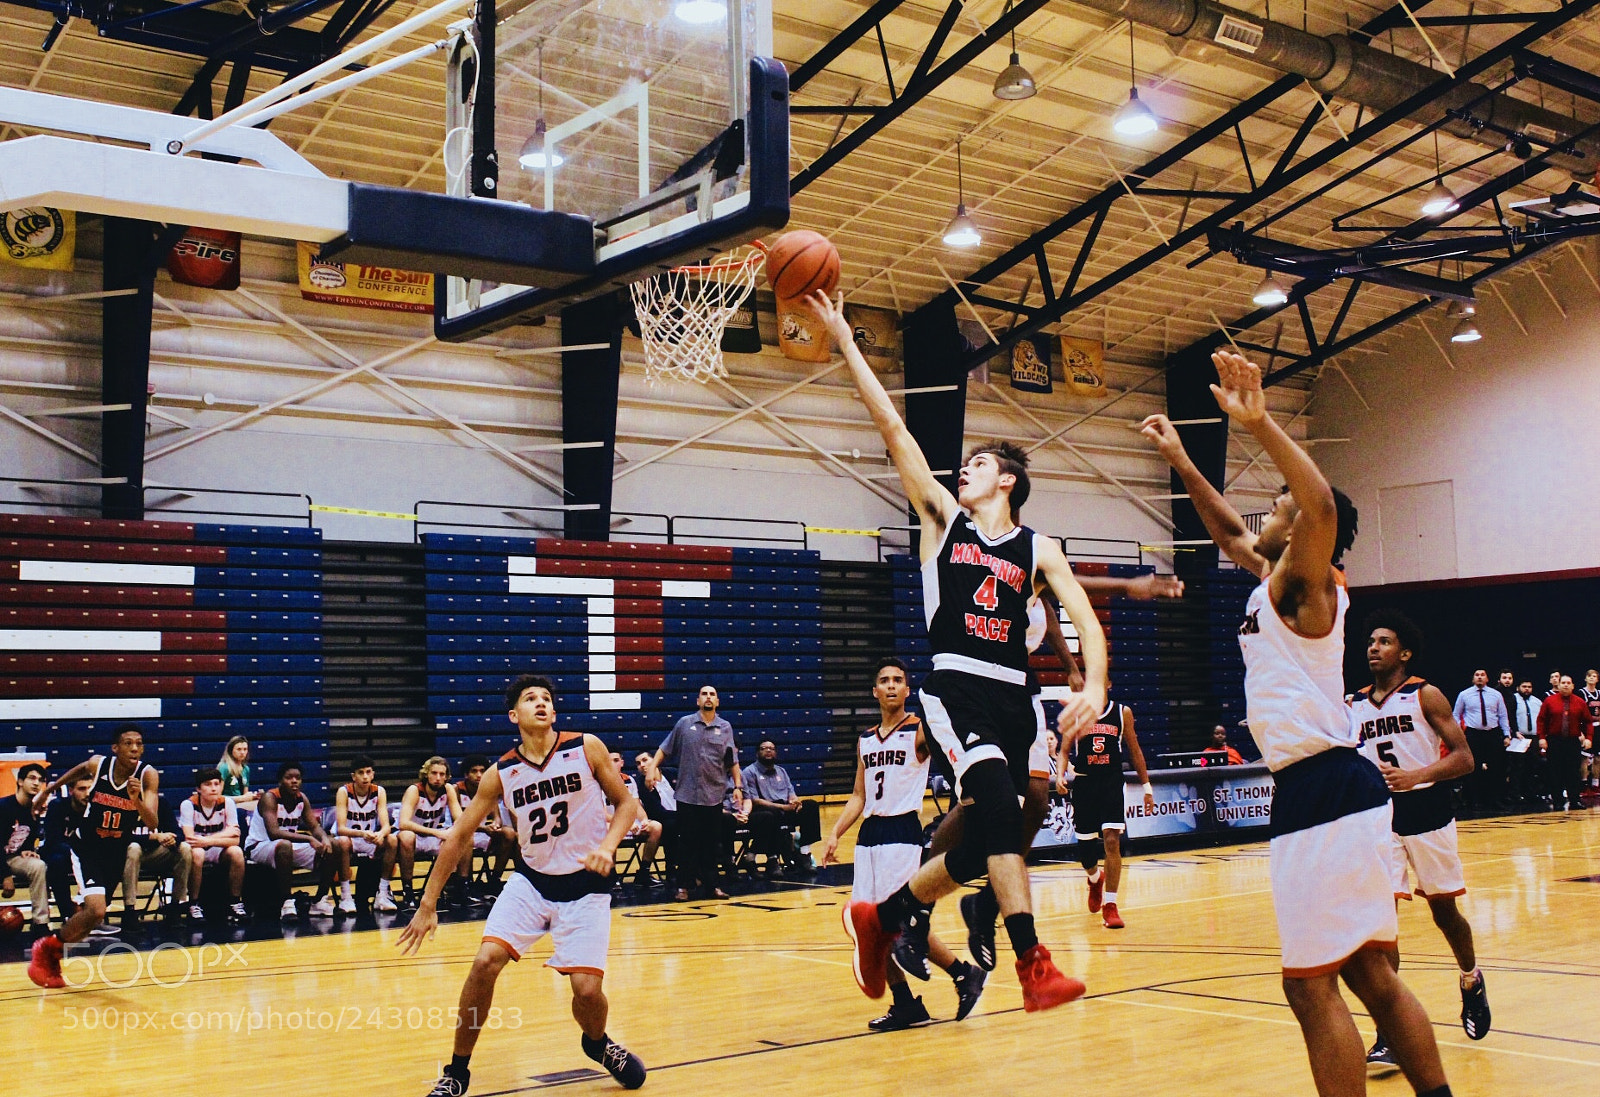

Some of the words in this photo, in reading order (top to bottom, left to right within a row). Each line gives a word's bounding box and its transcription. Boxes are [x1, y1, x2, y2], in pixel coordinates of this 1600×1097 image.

[358, 264, 393, 282] The
[394, 268, 430, 286] Sun
[357, 281, 427, 296] CONFERENCE
[972, 574, 999, 612] 4
[964, 612, 1012, 643] PACE
[1092, 736, 1106, 753] 5
[1087, 754, 1110, 766] PACE
[1376, 741, 1401, 768] 5
[512, 772, 582, 809] BEARS
[1213, 788, 1232, 803] ST.
[1189, 798, 1207, 813] TO
[1217, 804, 1271, 822] UNIVERS
[101, 810, 122, 829] 11
[528, 800, 569, 845] 23
